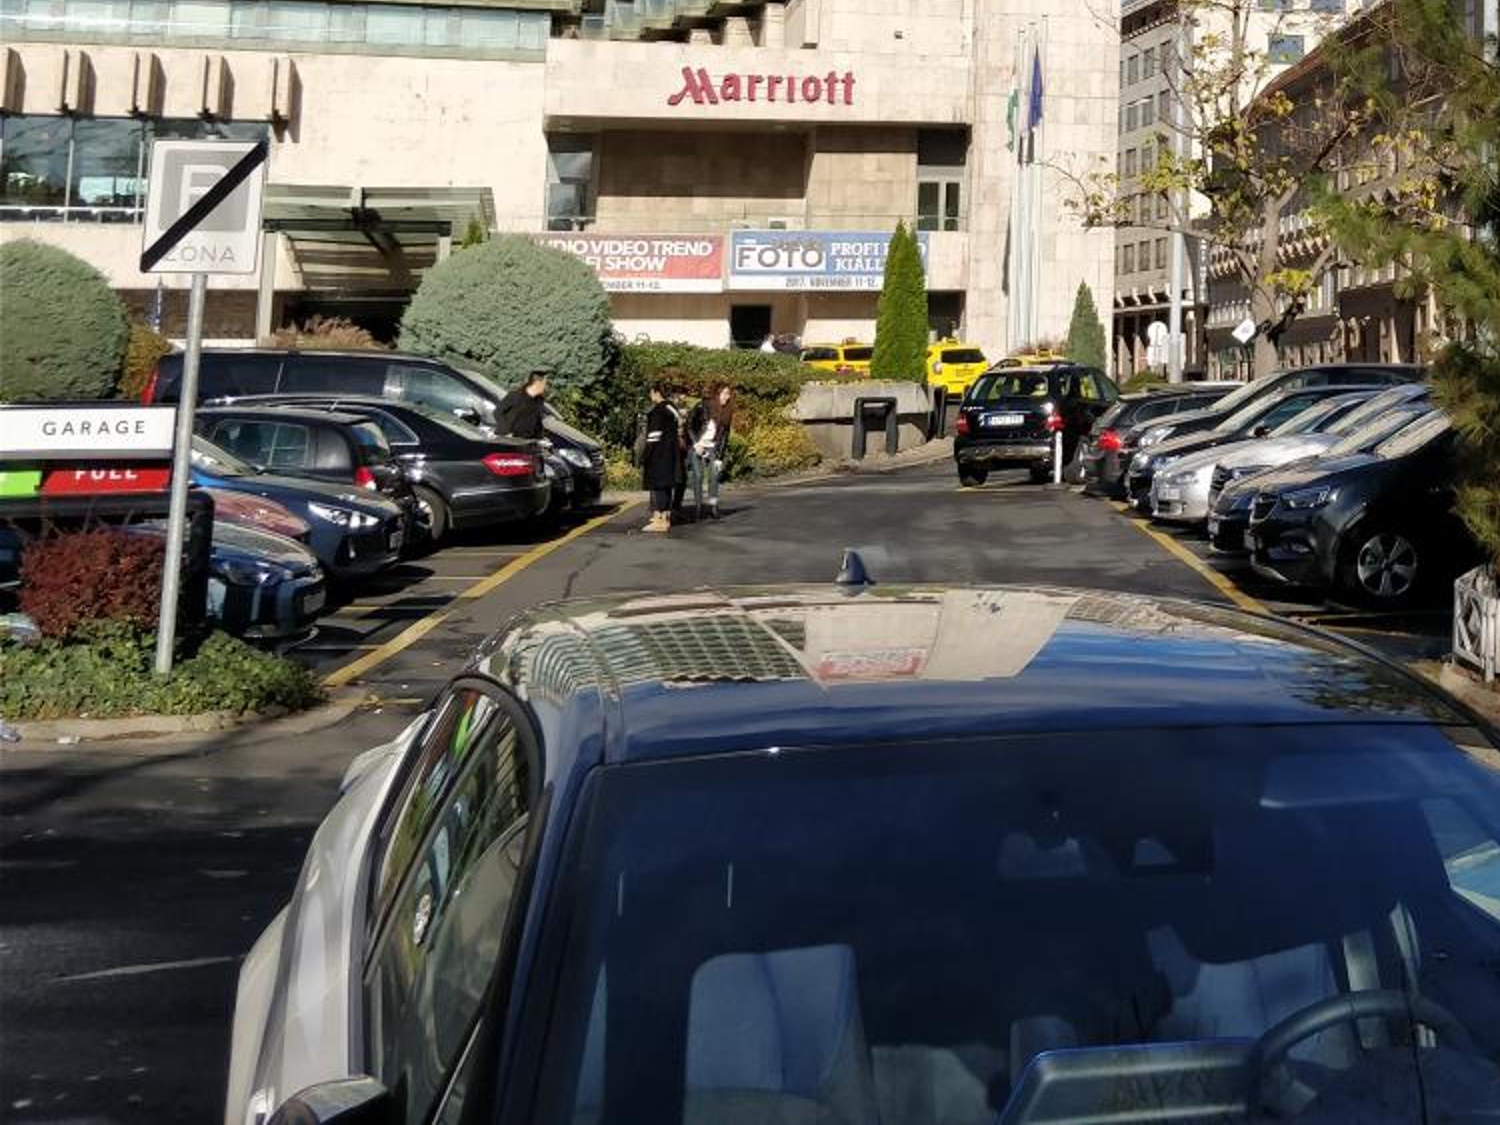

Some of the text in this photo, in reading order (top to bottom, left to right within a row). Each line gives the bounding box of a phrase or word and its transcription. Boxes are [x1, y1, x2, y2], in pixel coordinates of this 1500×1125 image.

[667, 66, 856, 106] Marriott
[165, 245, 235, 262] ONA
[590, 240, 649, 255] VIDEO
[653, 241, 712, 256] TREND
[830, 242, 880, 256] PROFI
[604, 256, 667, 271] SHOW
[737, 246, 824, 268] FOTO
[42, 420, 146, 436] GARAGE
